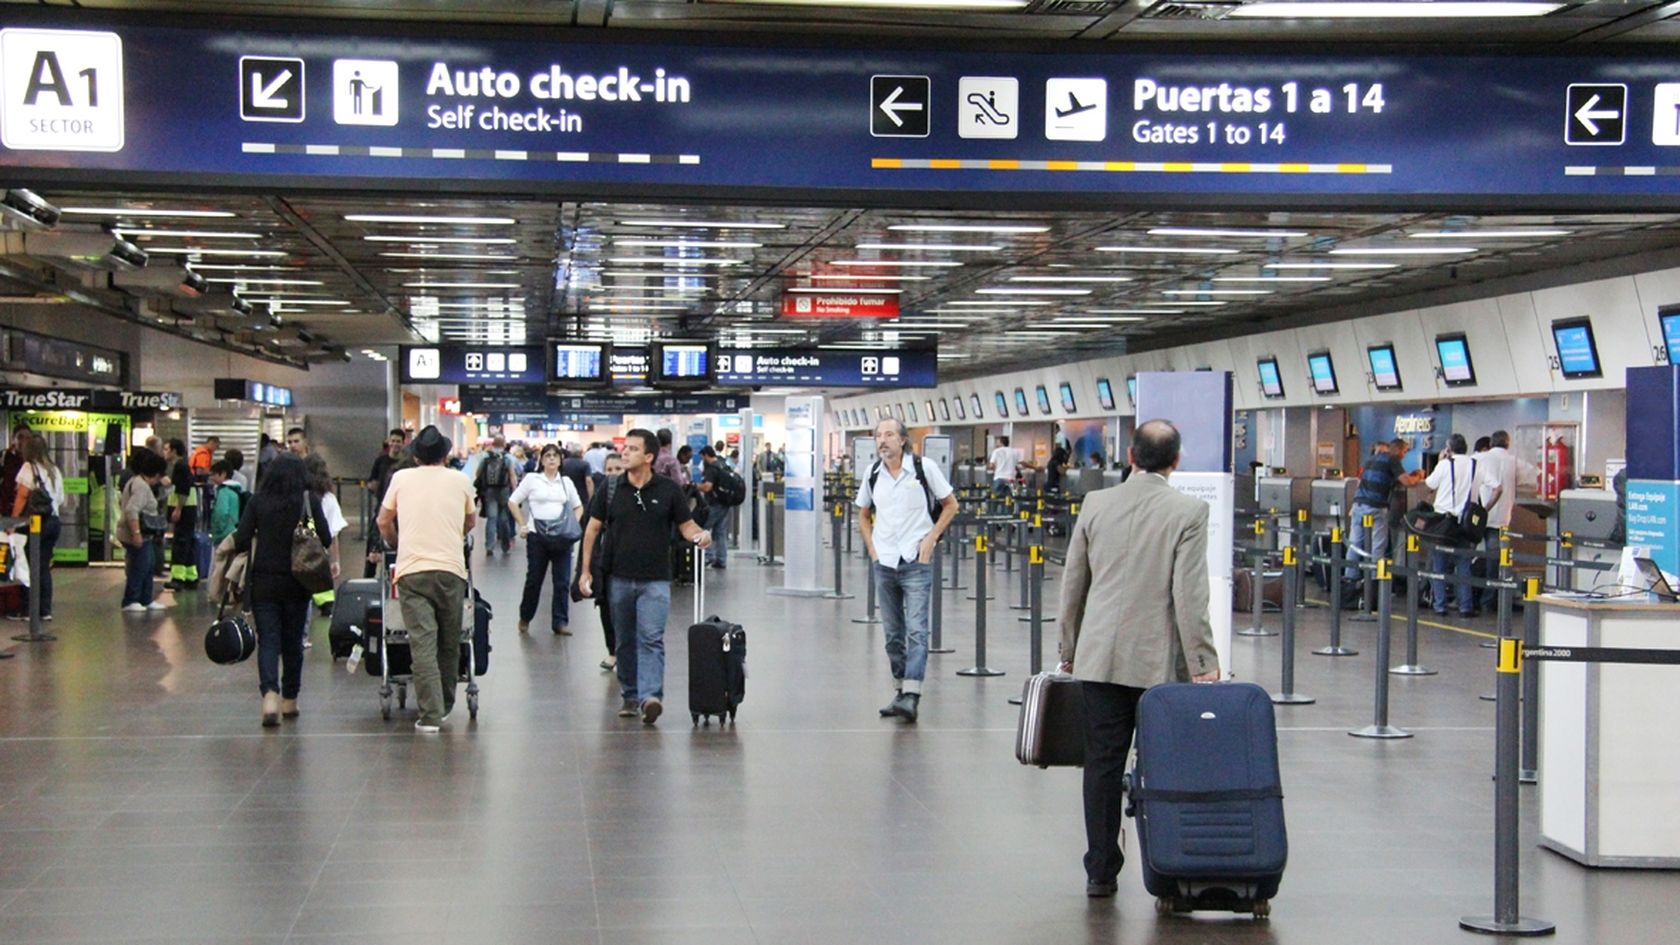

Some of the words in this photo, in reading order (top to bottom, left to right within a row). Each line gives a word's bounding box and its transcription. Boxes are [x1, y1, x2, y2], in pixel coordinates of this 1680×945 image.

[23, 51, 99, 107] A1
[426, 62, 519, 99] Auto
[530, 64, 690, 103] check-in
[1133, 79, 1271, 113] Puertas
[1282, 83, 1297, 112] 1
[1310, 91, 1332, 114] a
[1344, 83, 1384, 114] 14
[29, 118, 94, 134] SECTOR
[427, 106, 474, 131] Self
[478, 107, 582, 133] check-in
[1132, 121, 1201, 144] Gates
[1206, 122, 1217, 143] 1
[1224, 124, 1248, 144] to
[1257, 122, 1285, 145] 14
[816, 297, 857, 306] Prohibido
[757, 356, 779, 365] Auto
[781, 356, 819, 366] check-in
[1653, 345, 1667, 361] 26
[1549, 355, 1560, 369] 25
[6, 392, 84, 408] TrueStar
[13, 414, 84, 429] SecureBag
[1522, 649, 1554, 658] rgentina
[1553, 649, 1572, 657] 2000
